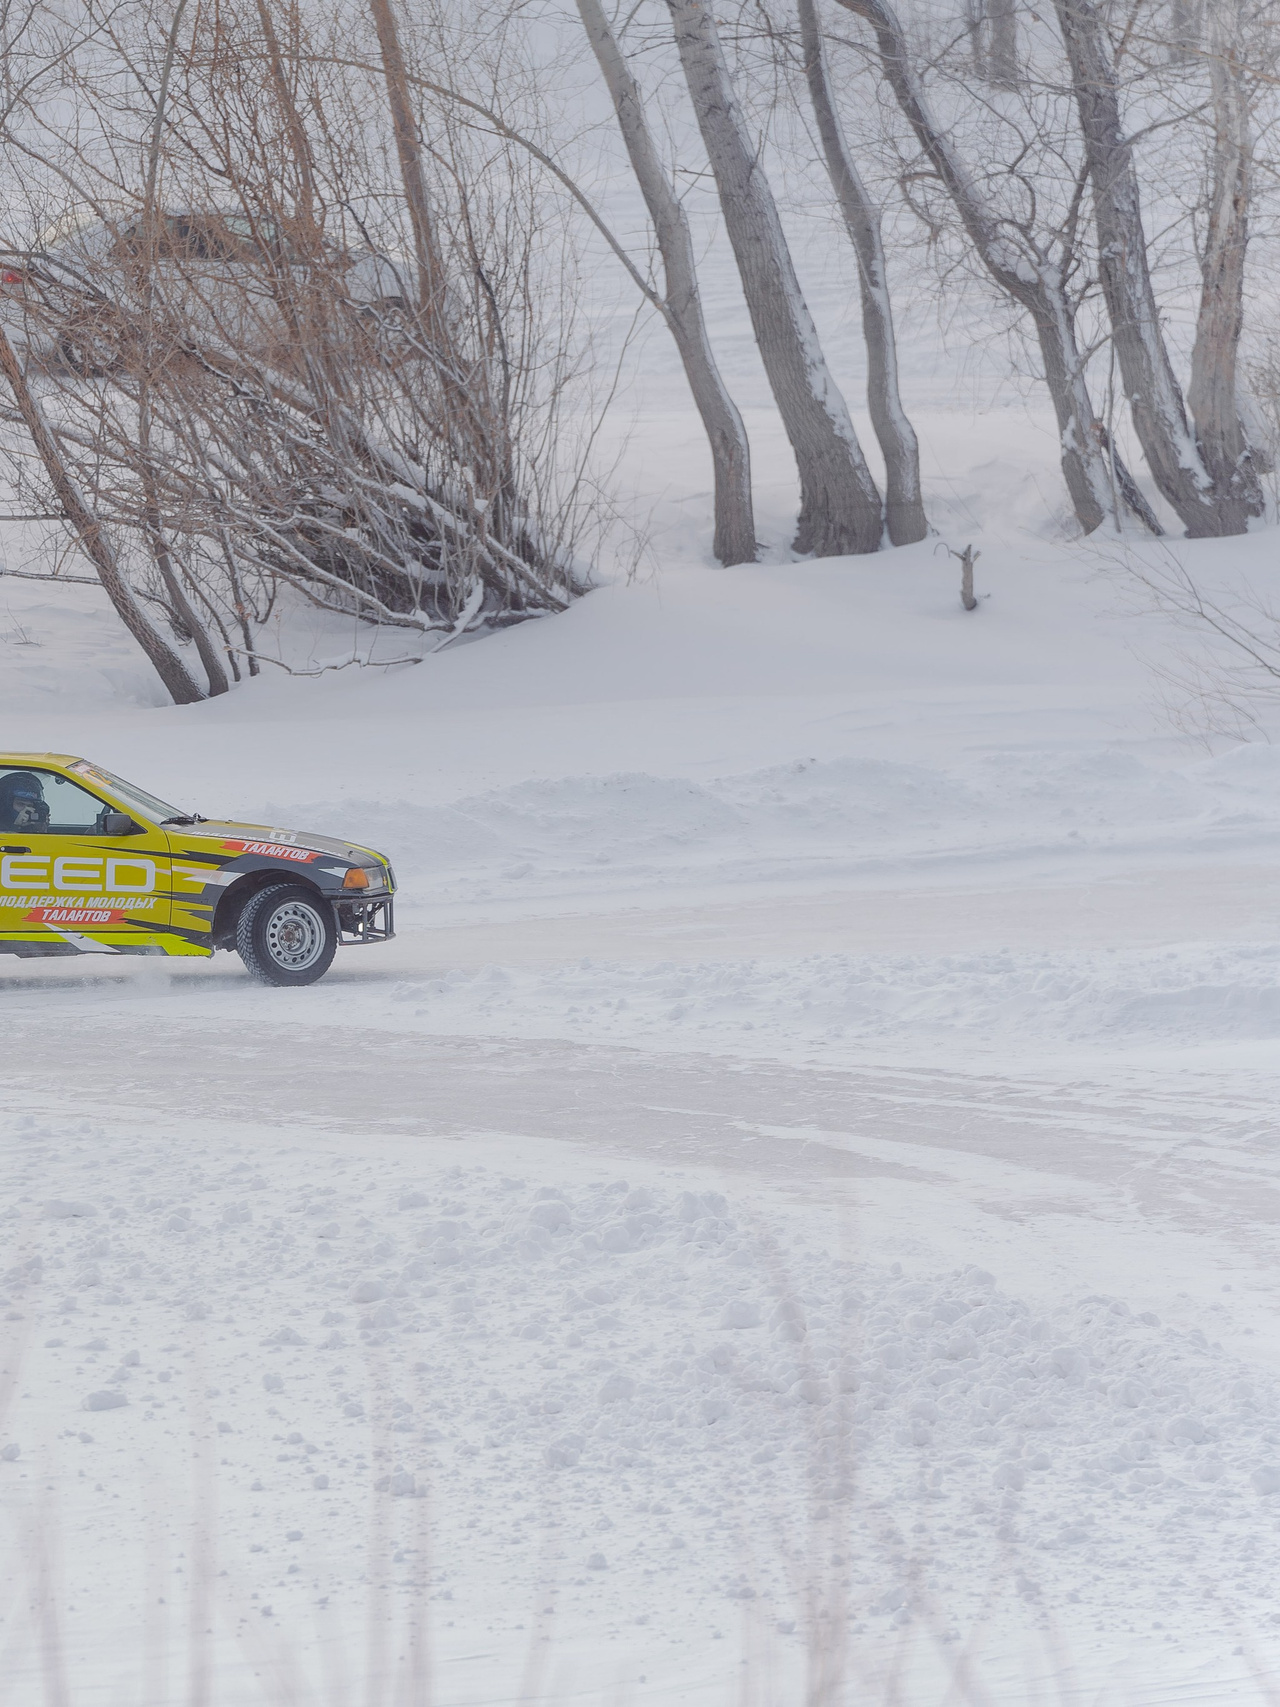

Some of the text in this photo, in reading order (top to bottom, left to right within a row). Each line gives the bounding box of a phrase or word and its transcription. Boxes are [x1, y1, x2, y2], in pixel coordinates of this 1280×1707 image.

[241, 842, 310, 860] ТАЛАНТОВ
[85, 897, 158, 910] МОЛОДЫХ
[41, 909, 112, 922] ТАЛАНТОВ
